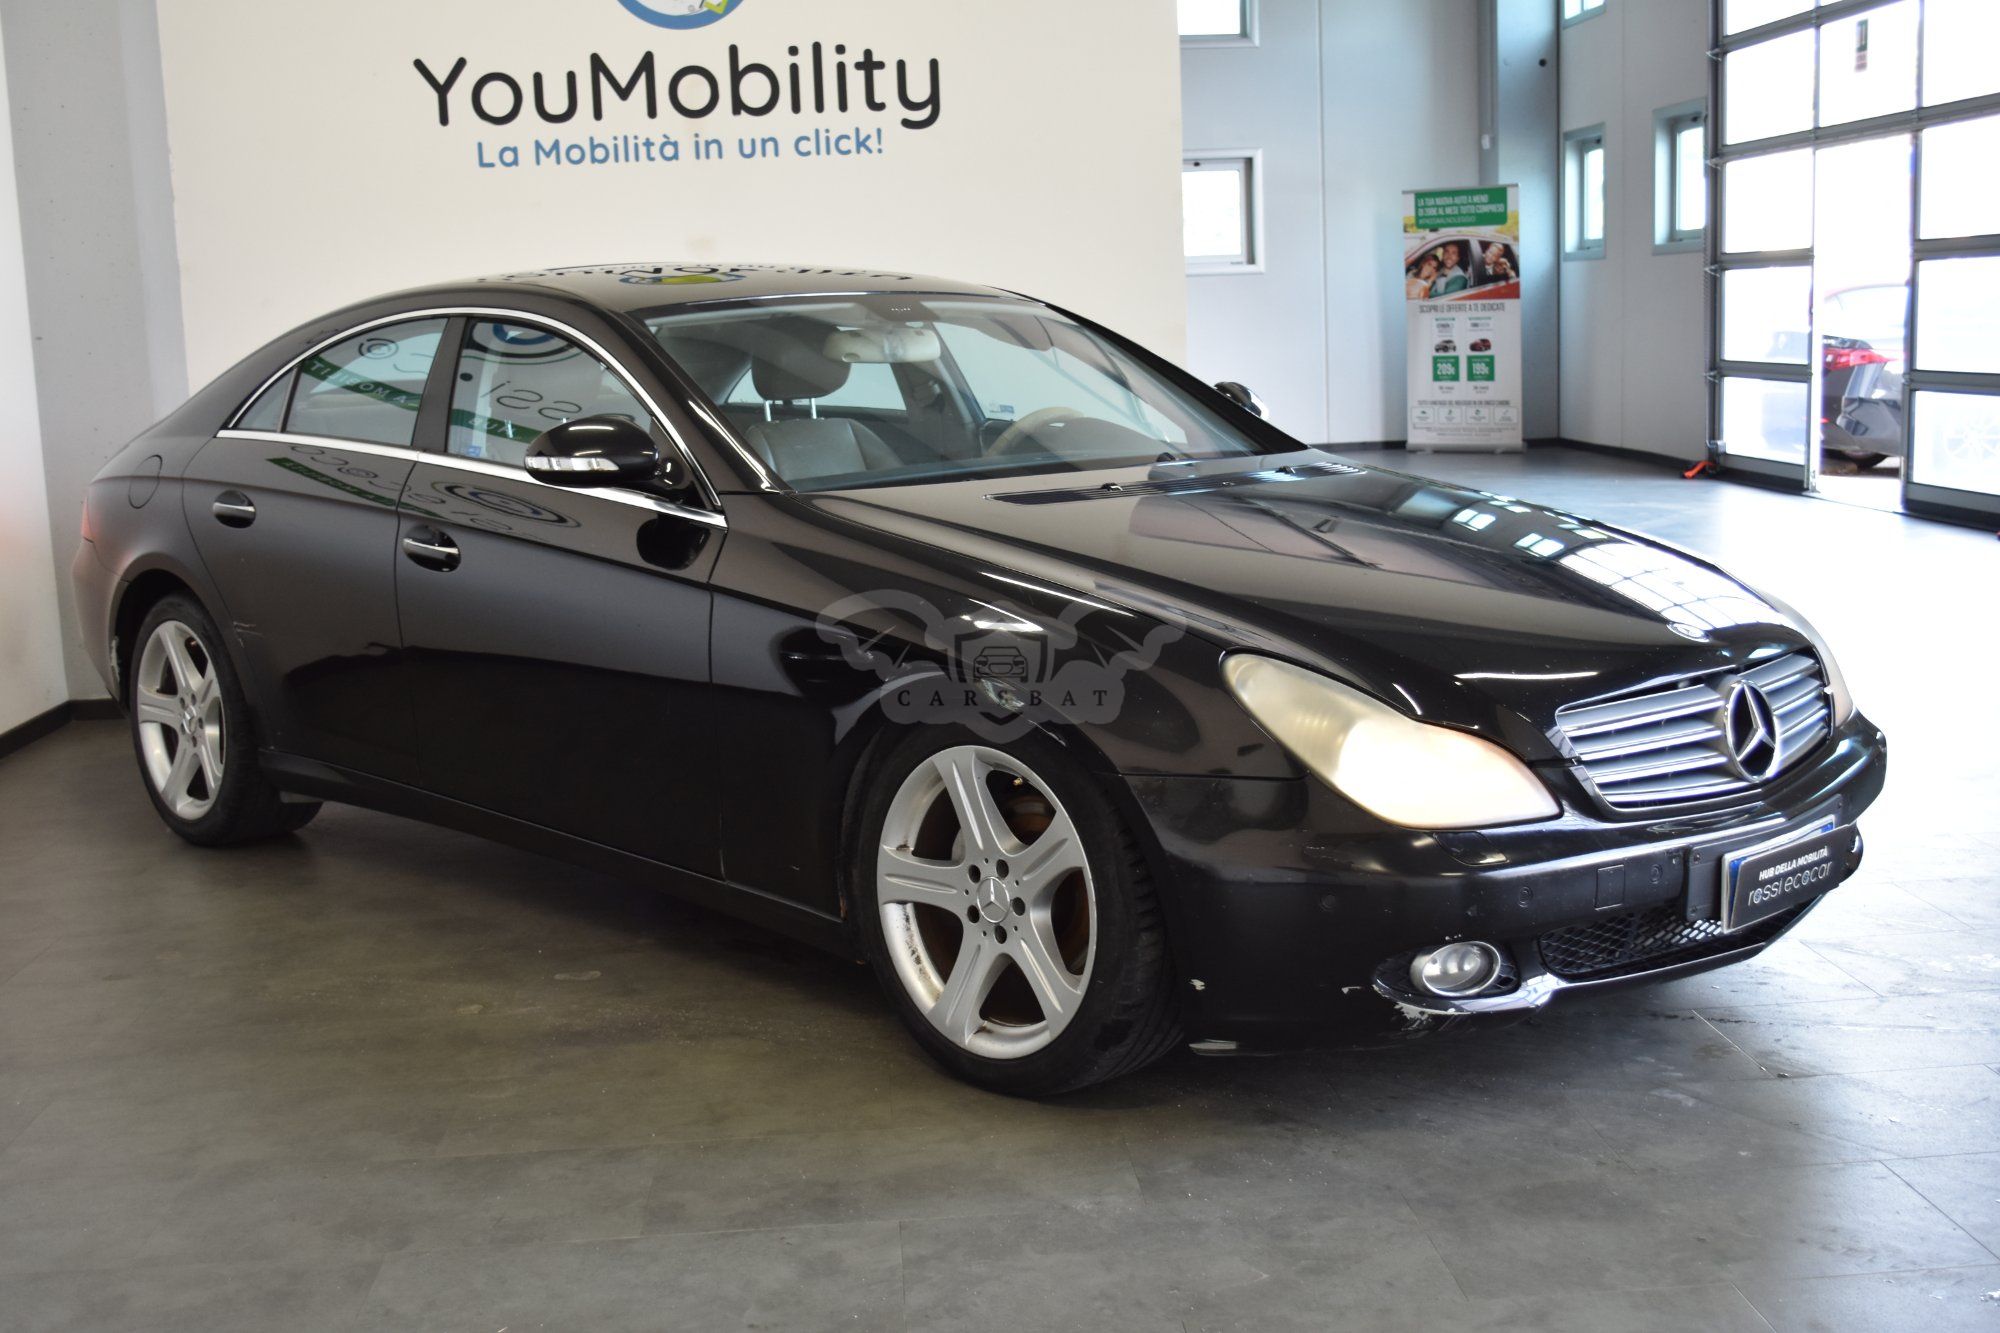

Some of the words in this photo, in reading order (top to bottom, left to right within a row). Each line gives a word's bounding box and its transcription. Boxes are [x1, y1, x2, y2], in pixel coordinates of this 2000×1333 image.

[413, 41, 941, 130] YouMobility
[476, 142, 520, 168] La
[534, 134, 680, 166] Mobilità
[694, 133, 724, 160] in
[738, 136, 780, 159] un
[793, 127, 884, 157] click!
[1419, 304, 1438, 313] SCOPRI
[1446, 303, 1467, 313] OFFERTE
[1480, 302, 1505, 312] DEDICATE
[1759, 866, 1775, 881] HUB
[1775, 859, 1797, 875] DELLA
[1797, 846, 1828, 867] MOBILITÀ
